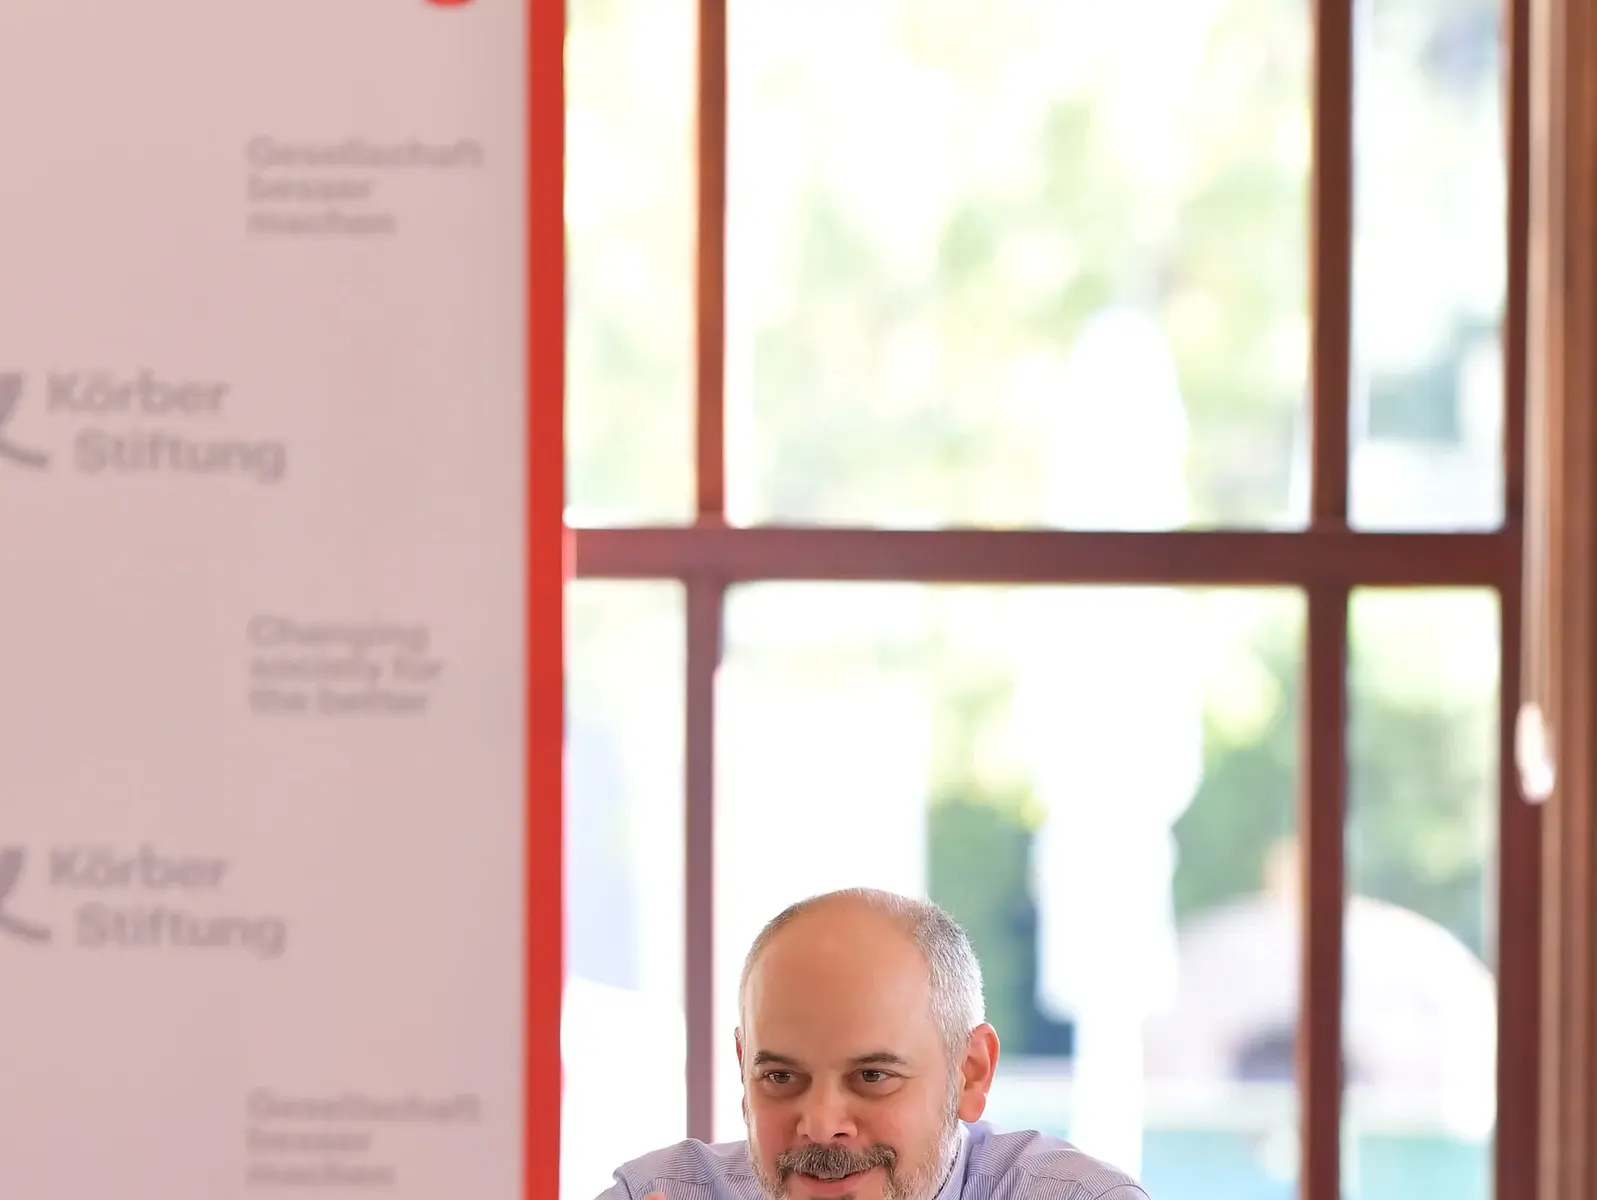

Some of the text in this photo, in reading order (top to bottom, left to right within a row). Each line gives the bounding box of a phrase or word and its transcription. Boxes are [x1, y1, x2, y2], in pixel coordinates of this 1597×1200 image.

[47, 366, 229, 413] Körber
[74, 427, 286, 482] Stiftung
[48, 844, 228, 888] Körber
[75, 901, 286, 958] Stiftung
